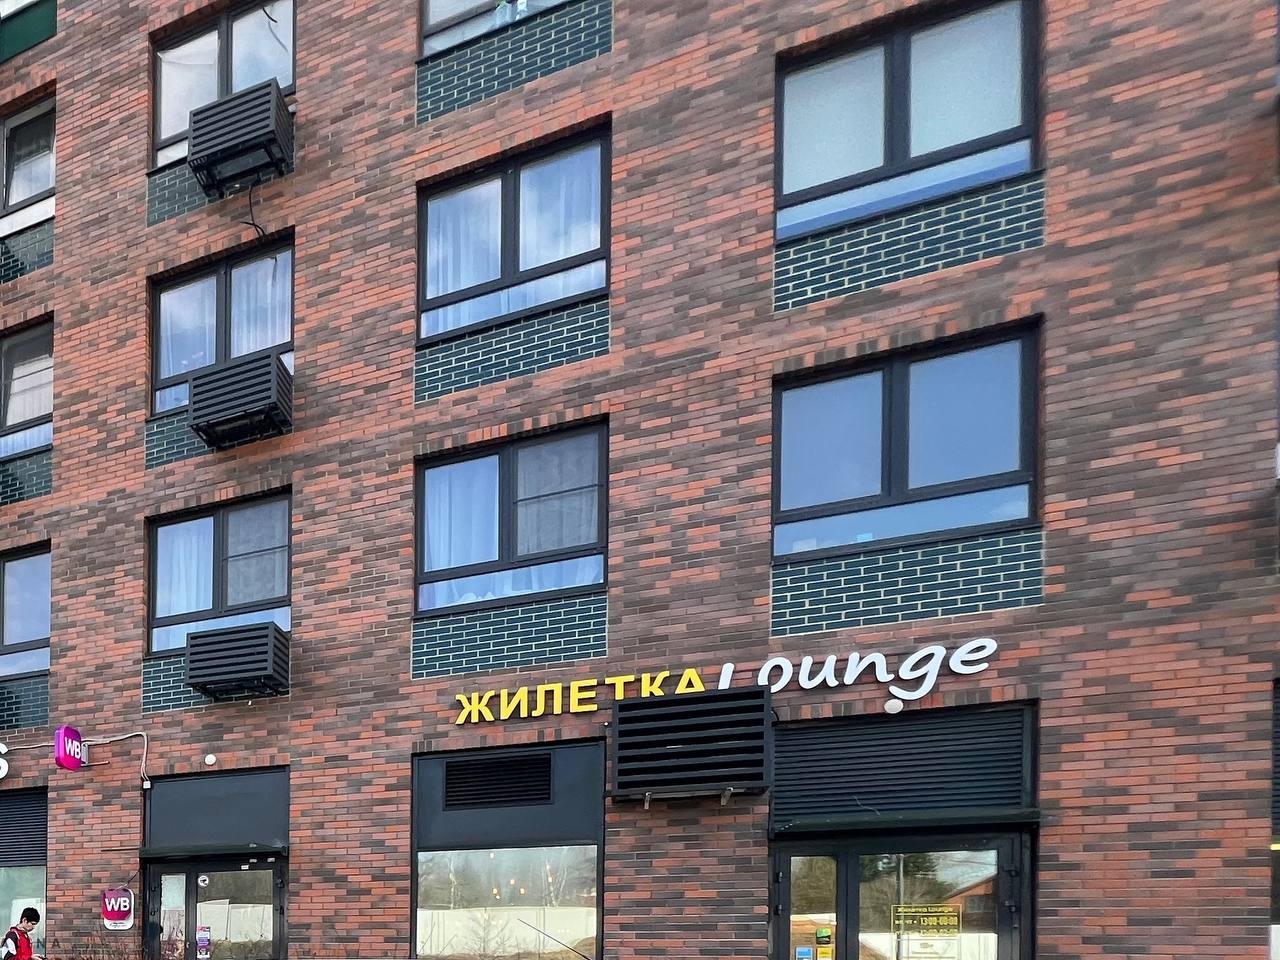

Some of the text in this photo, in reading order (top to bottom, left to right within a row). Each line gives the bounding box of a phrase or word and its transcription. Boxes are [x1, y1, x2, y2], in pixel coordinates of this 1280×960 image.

[454, 667, 706, 725] ЖИЛЕТКА
[64, 736, 81, 760] WB
[104, 897, 130, 912] WB
